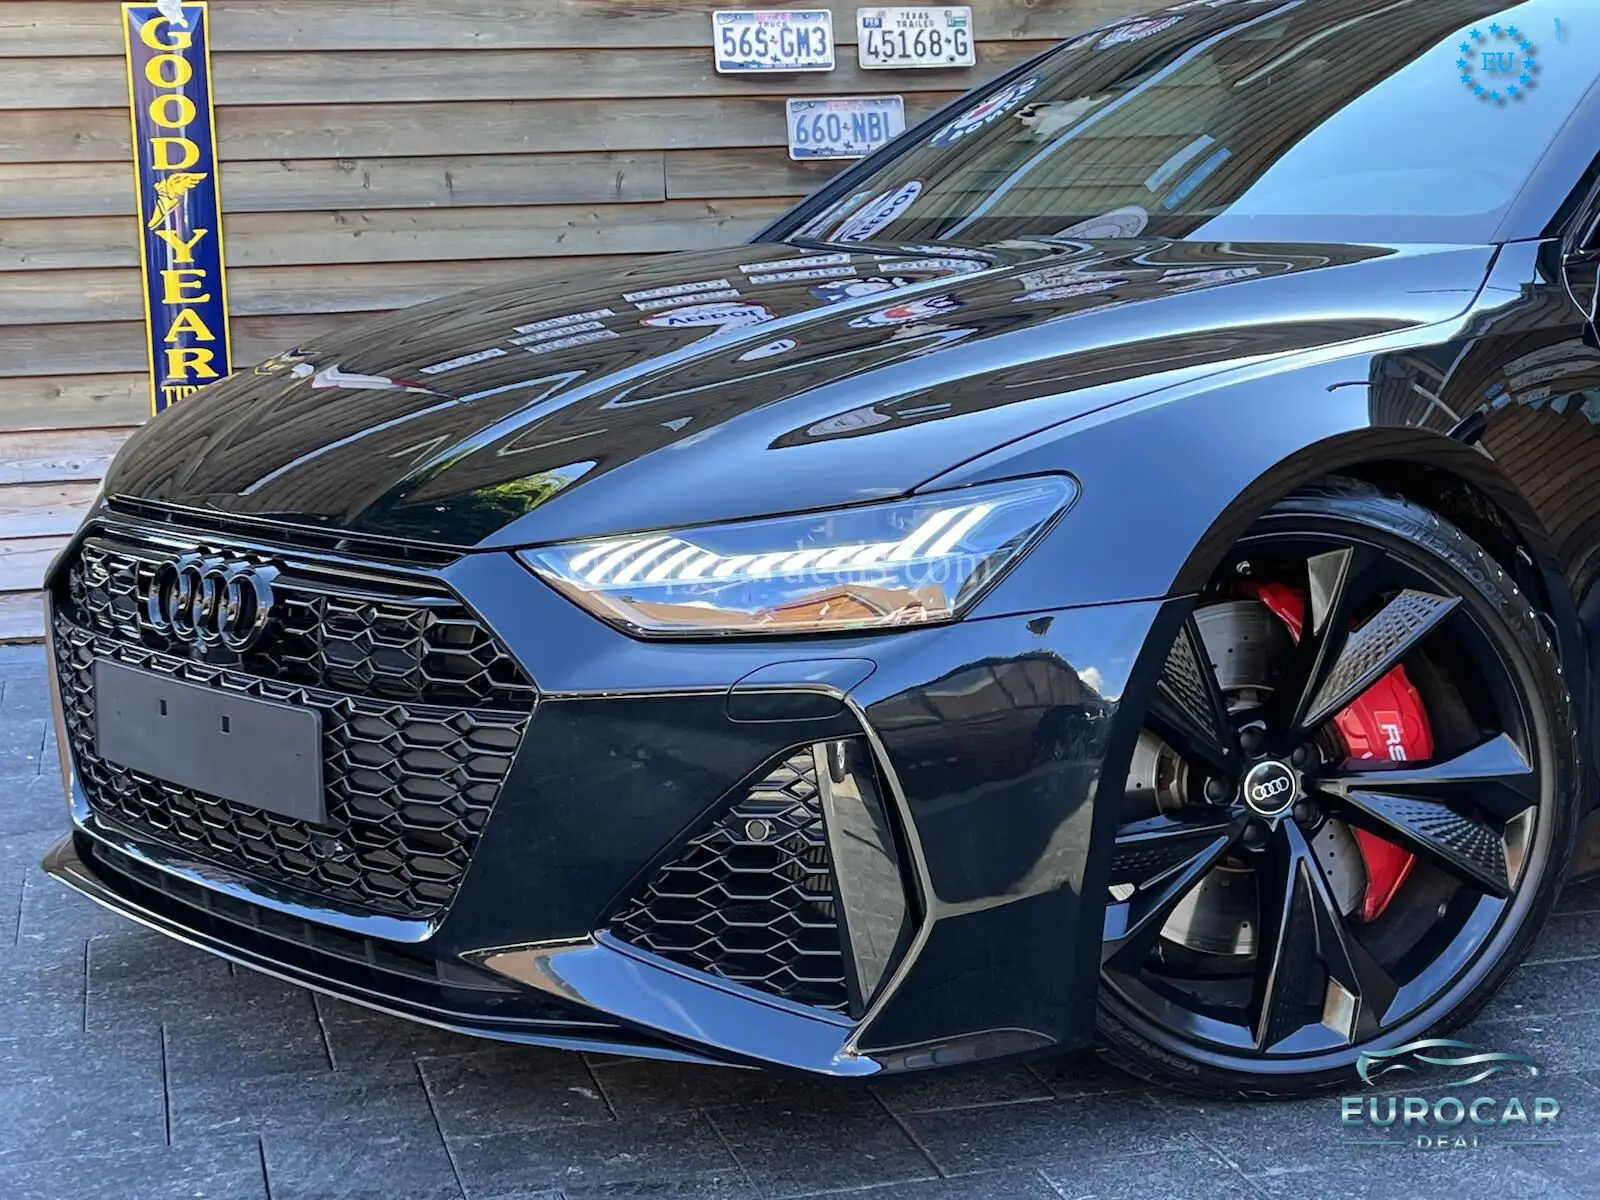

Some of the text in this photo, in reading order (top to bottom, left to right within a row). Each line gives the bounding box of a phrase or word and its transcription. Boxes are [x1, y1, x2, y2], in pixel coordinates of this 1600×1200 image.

[896, 20, 935, 28] TRAILER
[900, 12, 930, 20] TEXAS
[867, 29, 942, 58] 45168
[1381, 724, 1408, 761] RS
